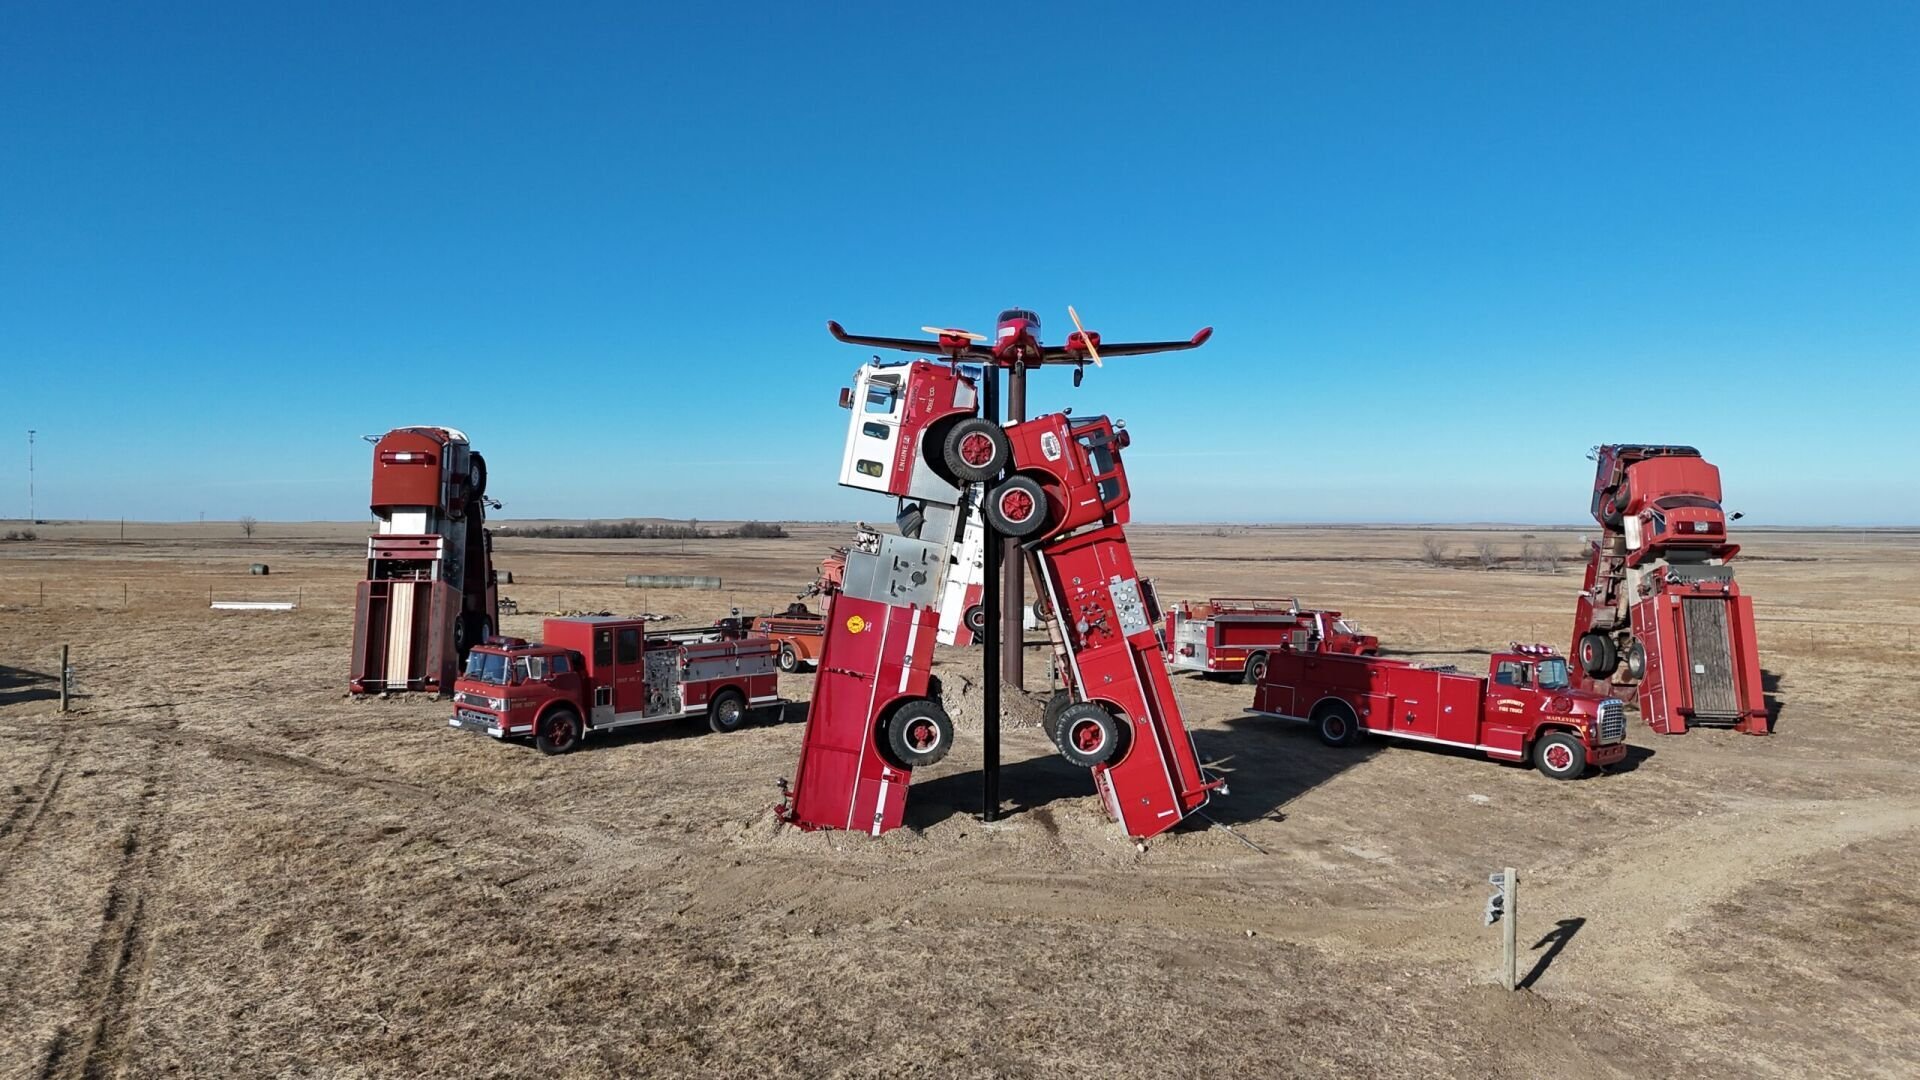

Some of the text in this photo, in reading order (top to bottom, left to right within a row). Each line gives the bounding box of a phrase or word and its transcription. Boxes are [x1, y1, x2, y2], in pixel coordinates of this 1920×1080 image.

[898, 443, 909, 471] ENGINE
[1497, 699, 1525, 707] COMMUNITY
[1546, 715, 1581, 723] MAPLEVIEW
